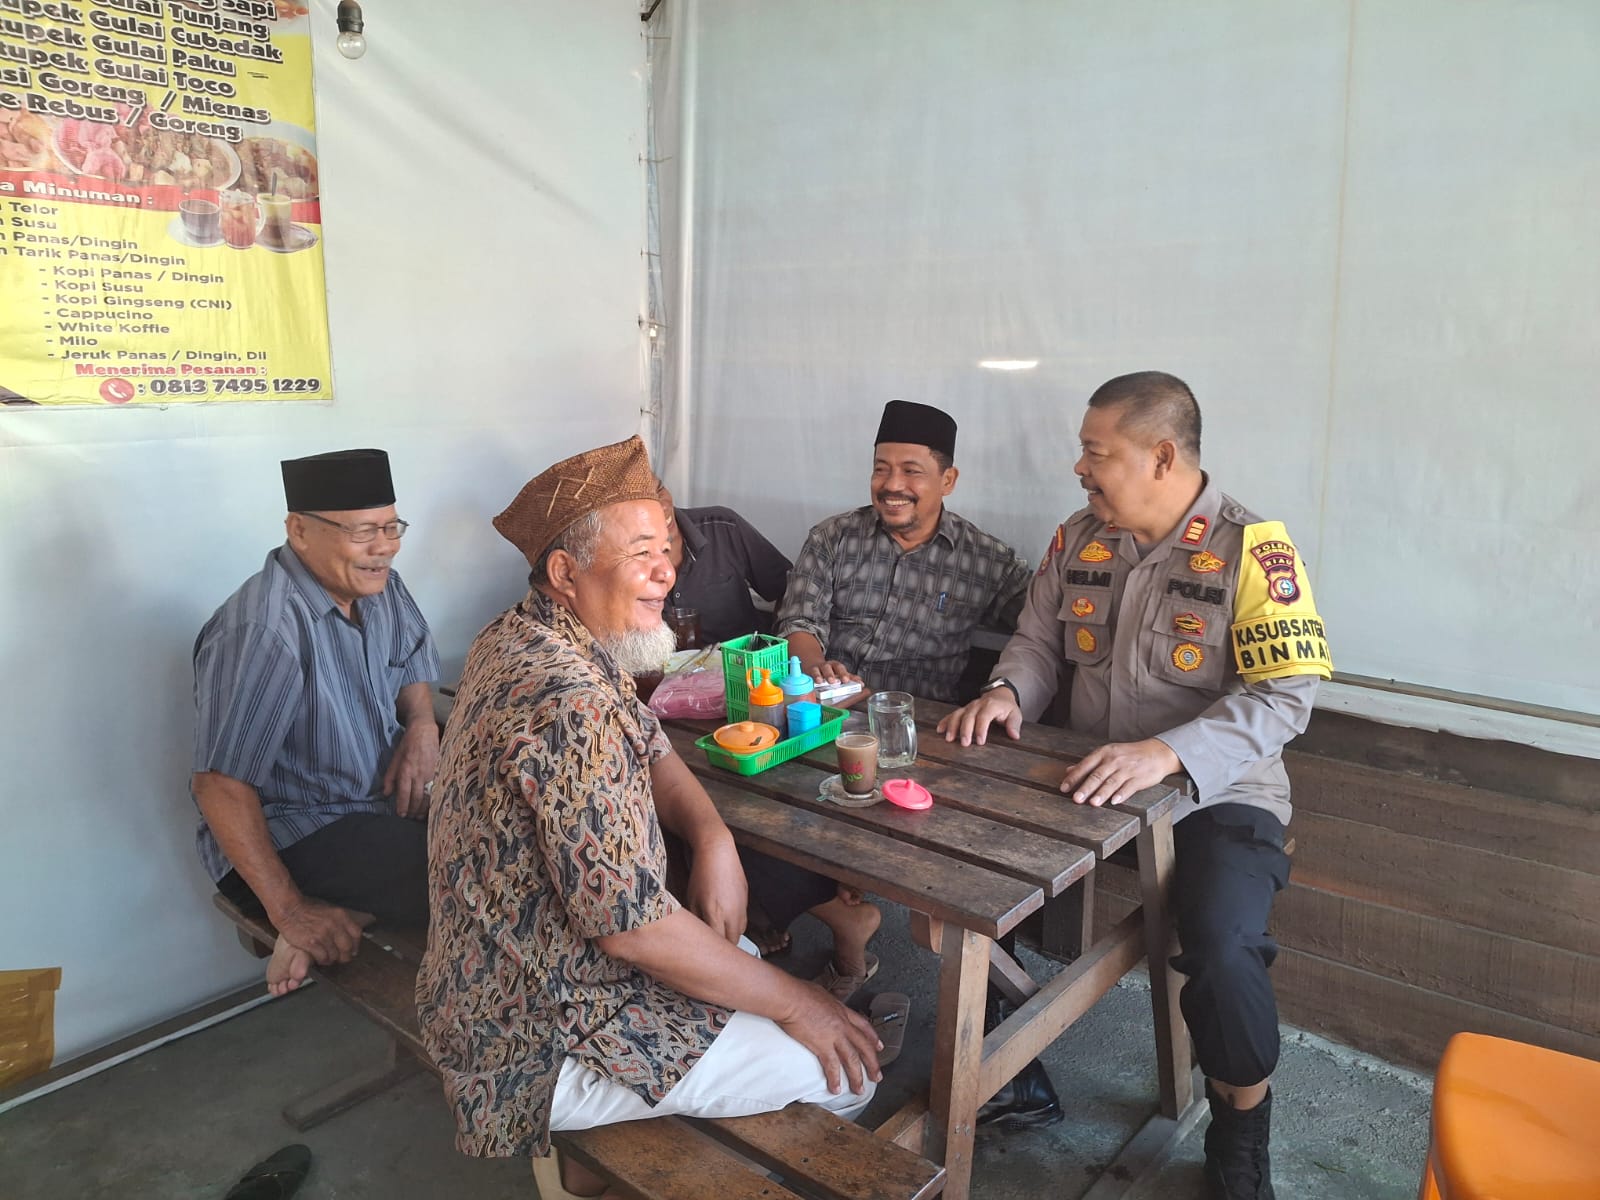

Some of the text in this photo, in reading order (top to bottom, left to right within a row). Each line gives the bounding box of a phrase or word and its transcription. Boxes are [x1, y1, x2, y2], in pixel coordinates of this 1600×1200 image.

[91, 0, 270, 41] ulai Tunjang
[89, 10, 165, 41] Gulai
[171, 27, 283, 63] Cubadak
[0, 17, 236, 77] upek Gulai Paku
[94, 58, 168, 87] Gulai
[173, 71, 235, 97] Toco
[0, 66, 271, 123] si Goreng / Mienas
[26, 93, 119, 123] Rebus
[126, 107, 142, 127] /
[150, 112, 243, 142] Goreng
[22, 180, 141, 204] Minuman
[8, 201, 59, 215] Telor
[11, 216, 57, 230] Susu
[13, 231, 138, 250] Panas/Dingin
[13, 246, 62, 259] Tarik
[68, 249, 186, 266] Panas/Dingin
[53, 265, 95, 278] Kopi
[101, 268, 153, 280] Panas
[172, 271, 224, 284] Dingin
[55, 279, 97, 292] Kopi
[102, 282, 144, 293] Susu
[55, 294, 98, 306] Kopi
[103, 296, 185, 309] Gingseng
[190, 299, 232, 310] (CNI)
[56, 308, 153, 320] Cappucino
[57, 322, 113, 333] White
[119, 323, 170, 334] Koffie
[59, 336, 98, 346] Milo
[61, 350, 111, 360] Jeruk
[117, 350, 167, 360] Panas
[75, 363, 176, 376] Menerima
[180, 364, 257, 376] Pesanan
[150, 379, 207, 394] 0813
[212, 379, 268, 393] 7495
[272, 378, 320, 393] 1229
